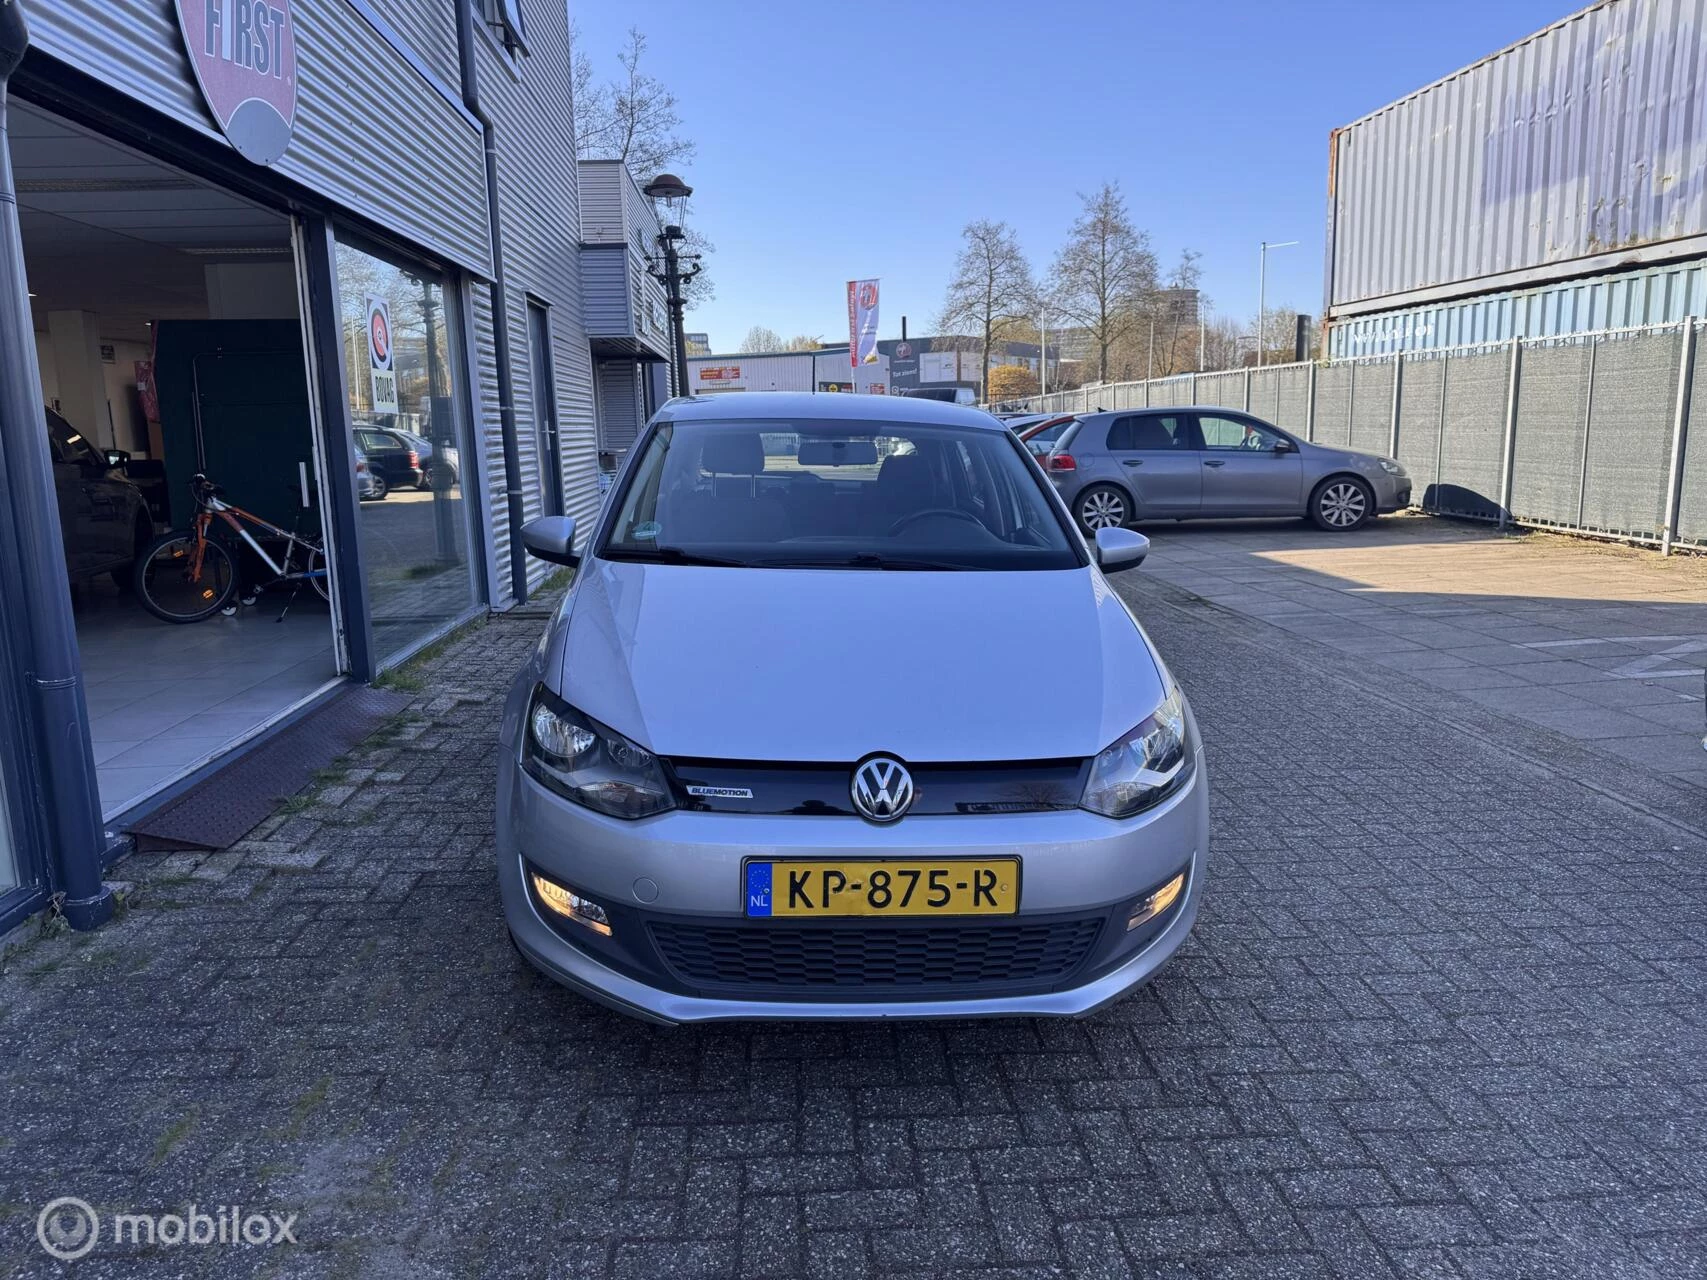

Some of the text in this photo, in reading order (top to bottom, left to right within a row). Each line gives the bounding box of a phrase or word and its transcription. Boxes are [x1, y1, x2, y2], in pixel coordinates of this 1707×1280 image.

[205, 0, 285, 80] FIRST
[375, 376, 395, 403] BOVAG
[691, 787, 749, 797] BLUEMOTION
[750, 895, 769, 907] NL
[788, 869, 999, 909] KP-875-R
